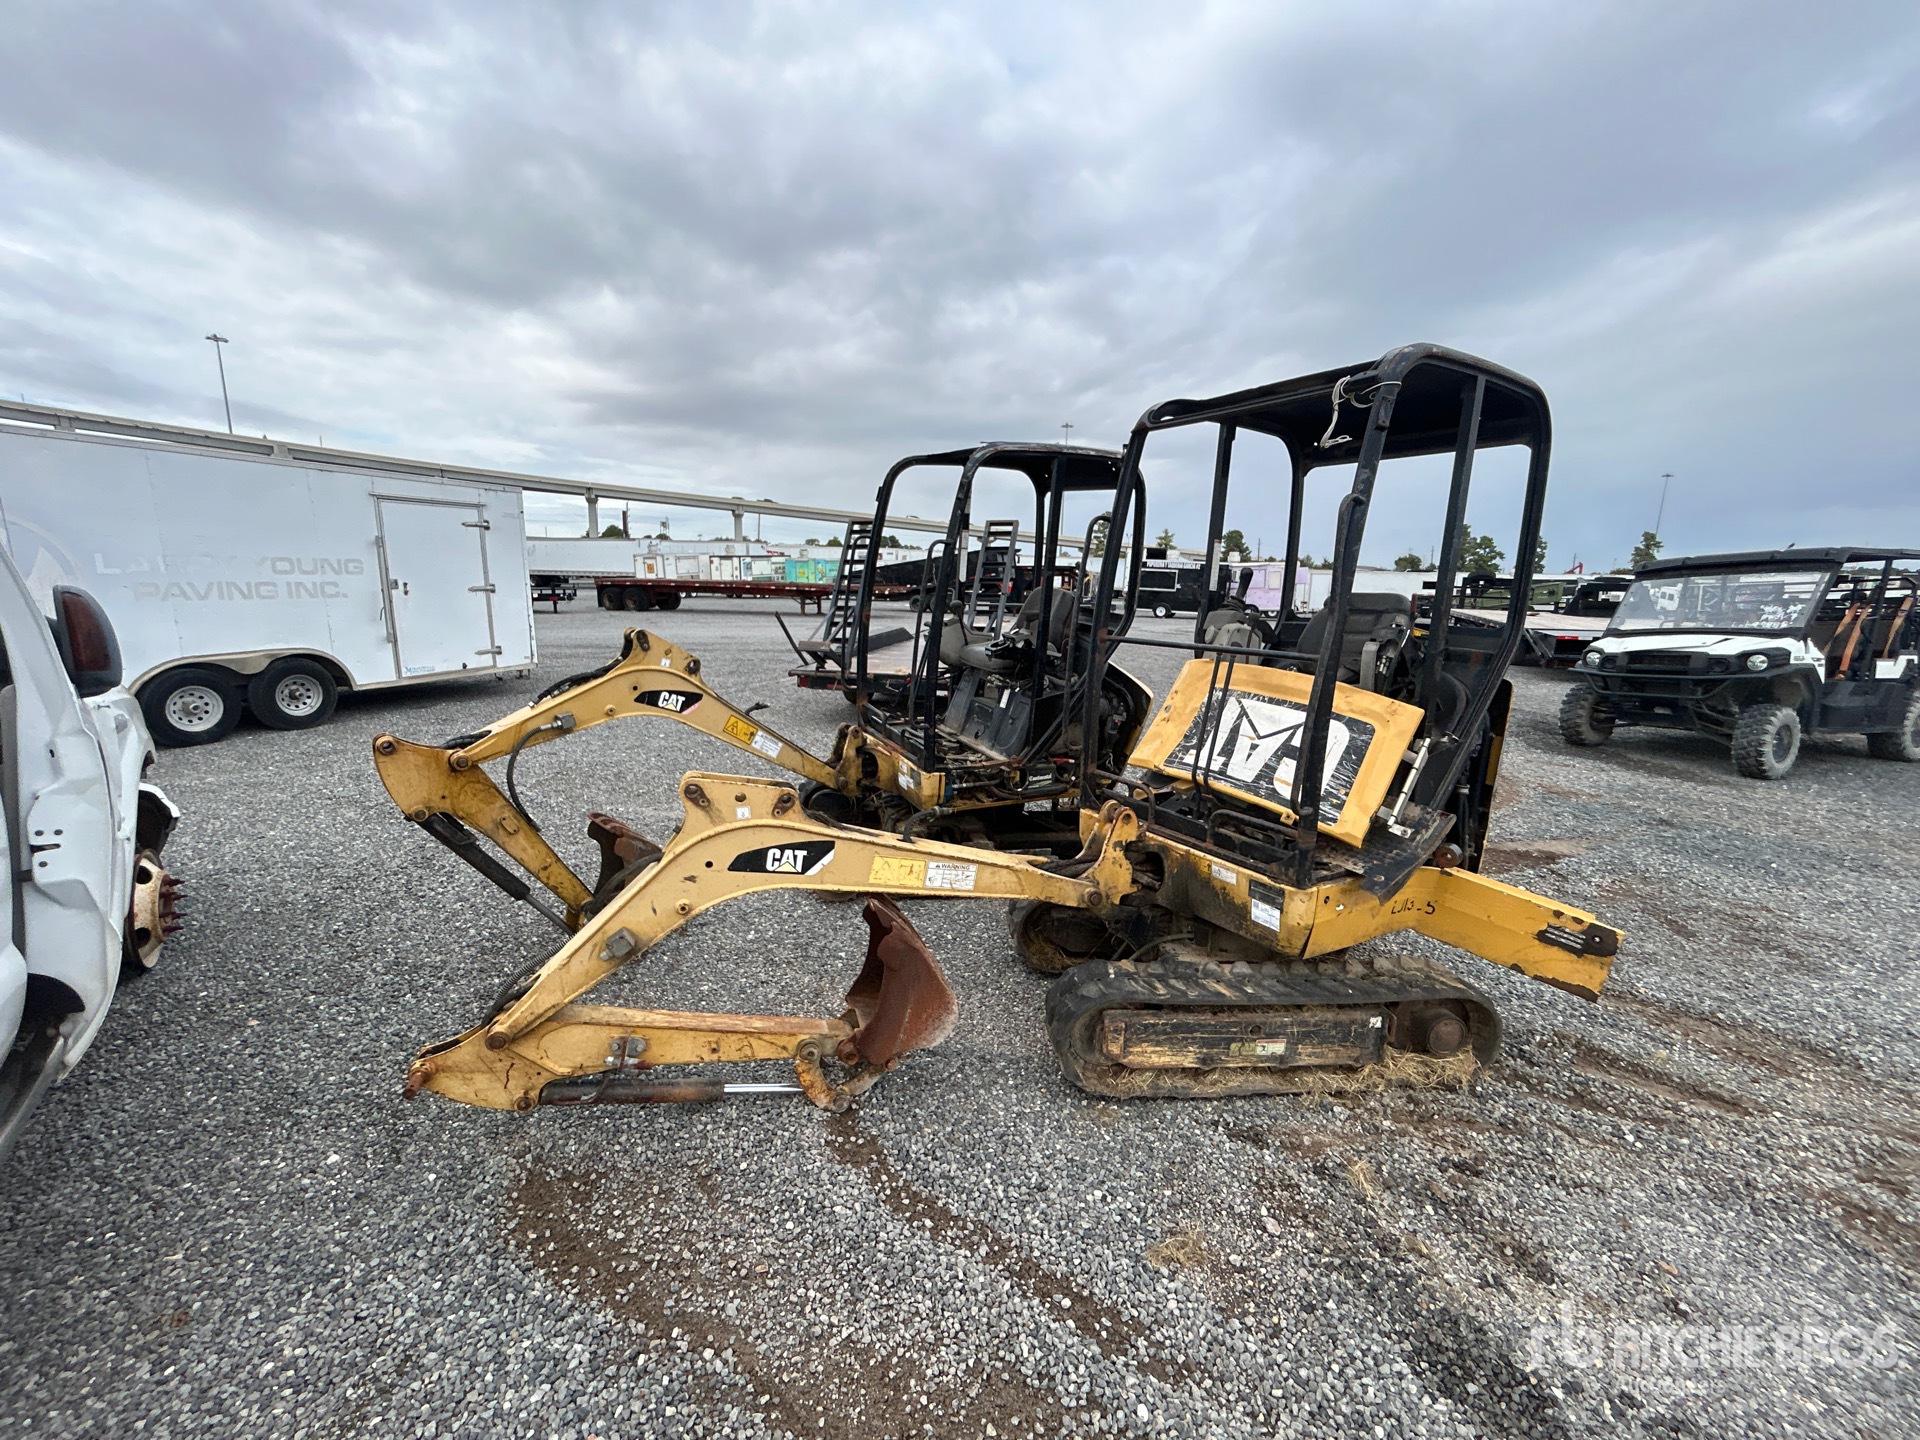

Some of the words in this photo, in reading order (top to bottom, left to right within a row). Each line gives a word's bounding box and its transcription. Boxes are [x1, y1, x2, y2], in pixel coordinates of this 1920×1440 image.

[132, 580, 280, 601] PAVING
[286, 580, 349, 599] INC.
[658, 691, 686, 712] CAT
[766, 847, 808, 873] CAT
[941, 863, 971, 871] WARNING
